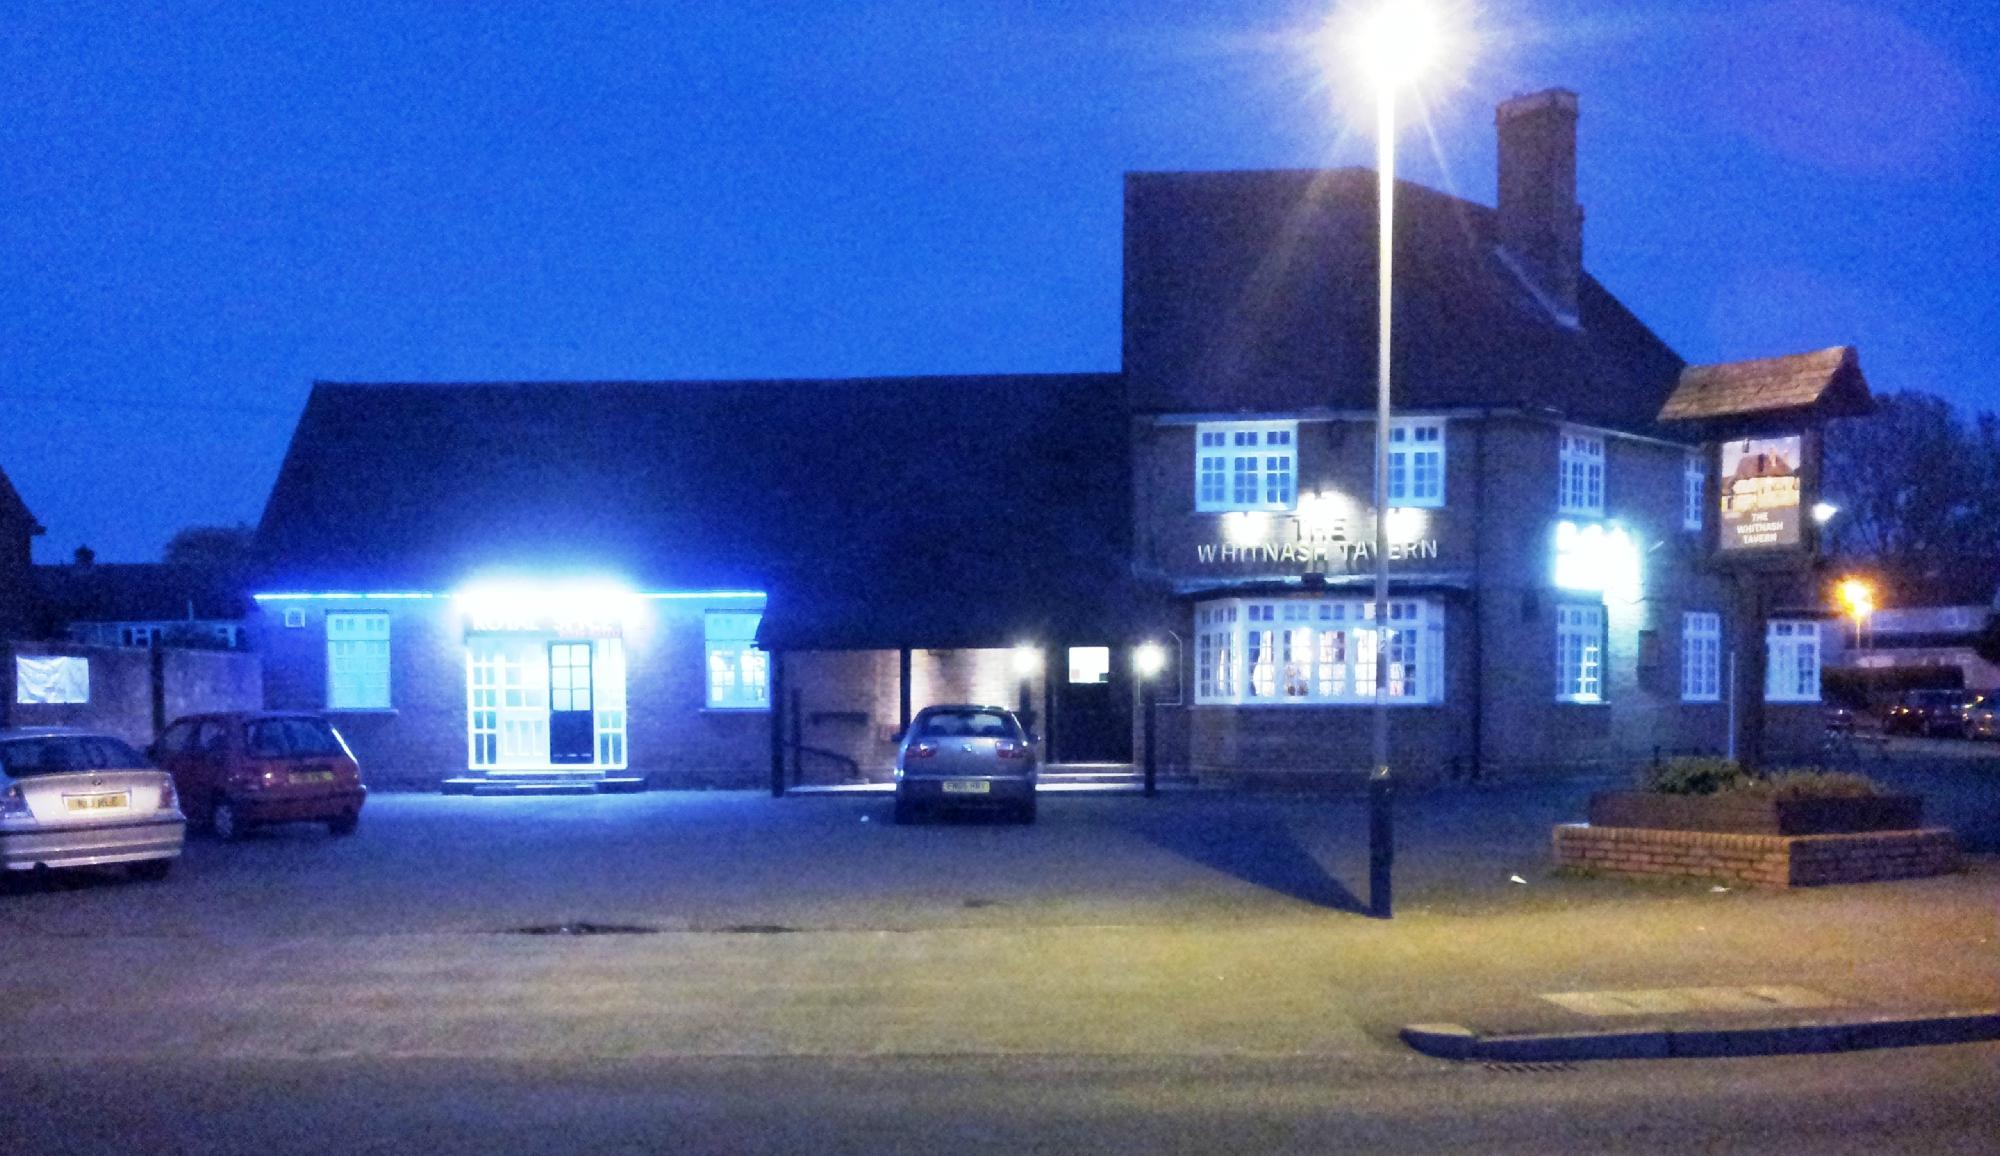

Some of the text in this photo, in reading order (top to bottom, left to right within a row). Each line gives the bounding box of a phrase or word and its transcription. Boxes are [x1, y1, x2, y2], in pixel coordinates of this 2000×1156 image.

[1752, 512, 1768, 521] THE
[1292, 516, 1347, 542] THE
[1737, 521, 1783, 534] WHITNASH
[1743, 533, 1777, 544] TAVERN
[1197, 542, 1328, 563] WHITNASH
